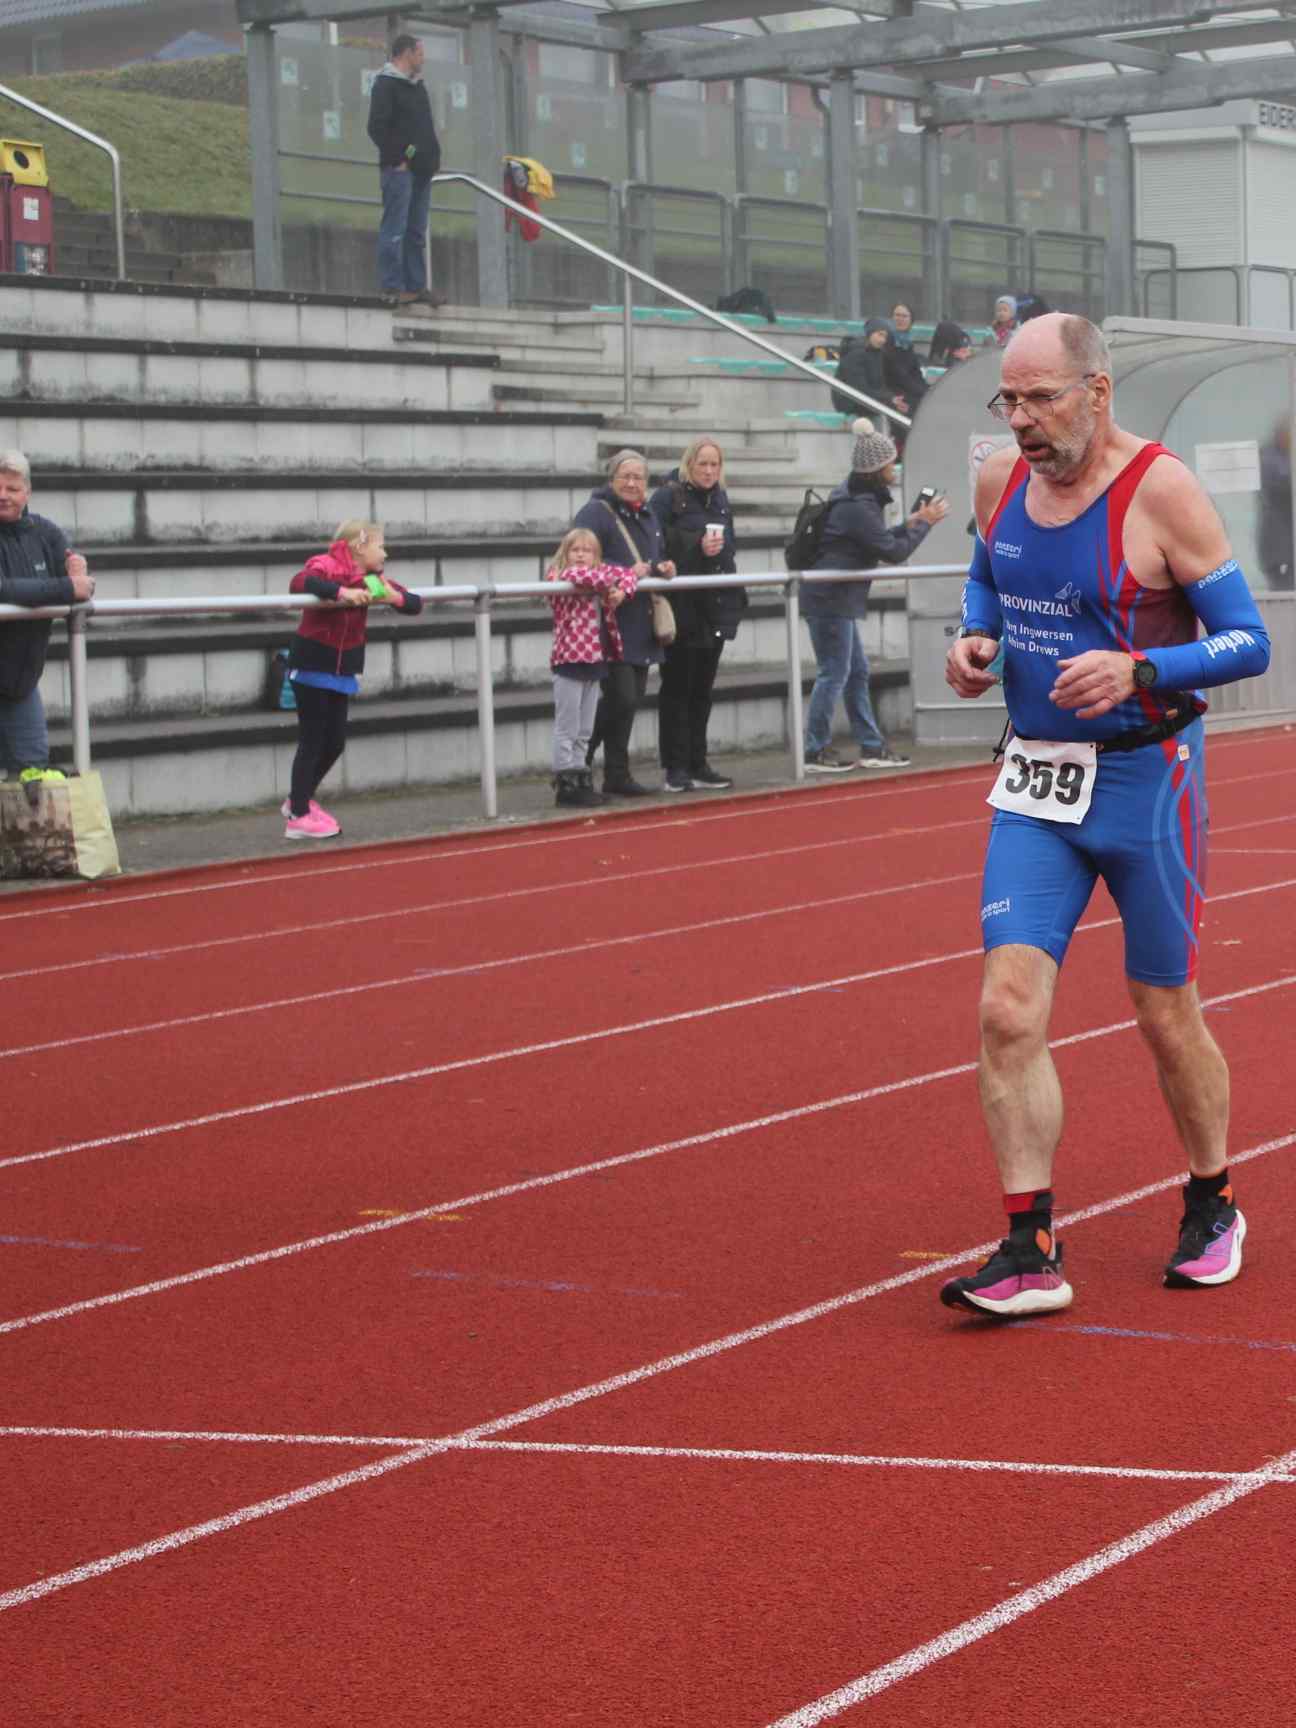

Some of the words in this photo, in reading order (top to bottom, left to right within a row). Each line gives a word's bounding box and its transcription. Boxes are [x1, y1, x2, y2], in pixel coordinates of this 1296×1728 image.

[1019, 623, 1074, 641] Ingwersen
[1202, 629, 1256, 660] Norbert
[1005, 753, 1086, 806] 359
